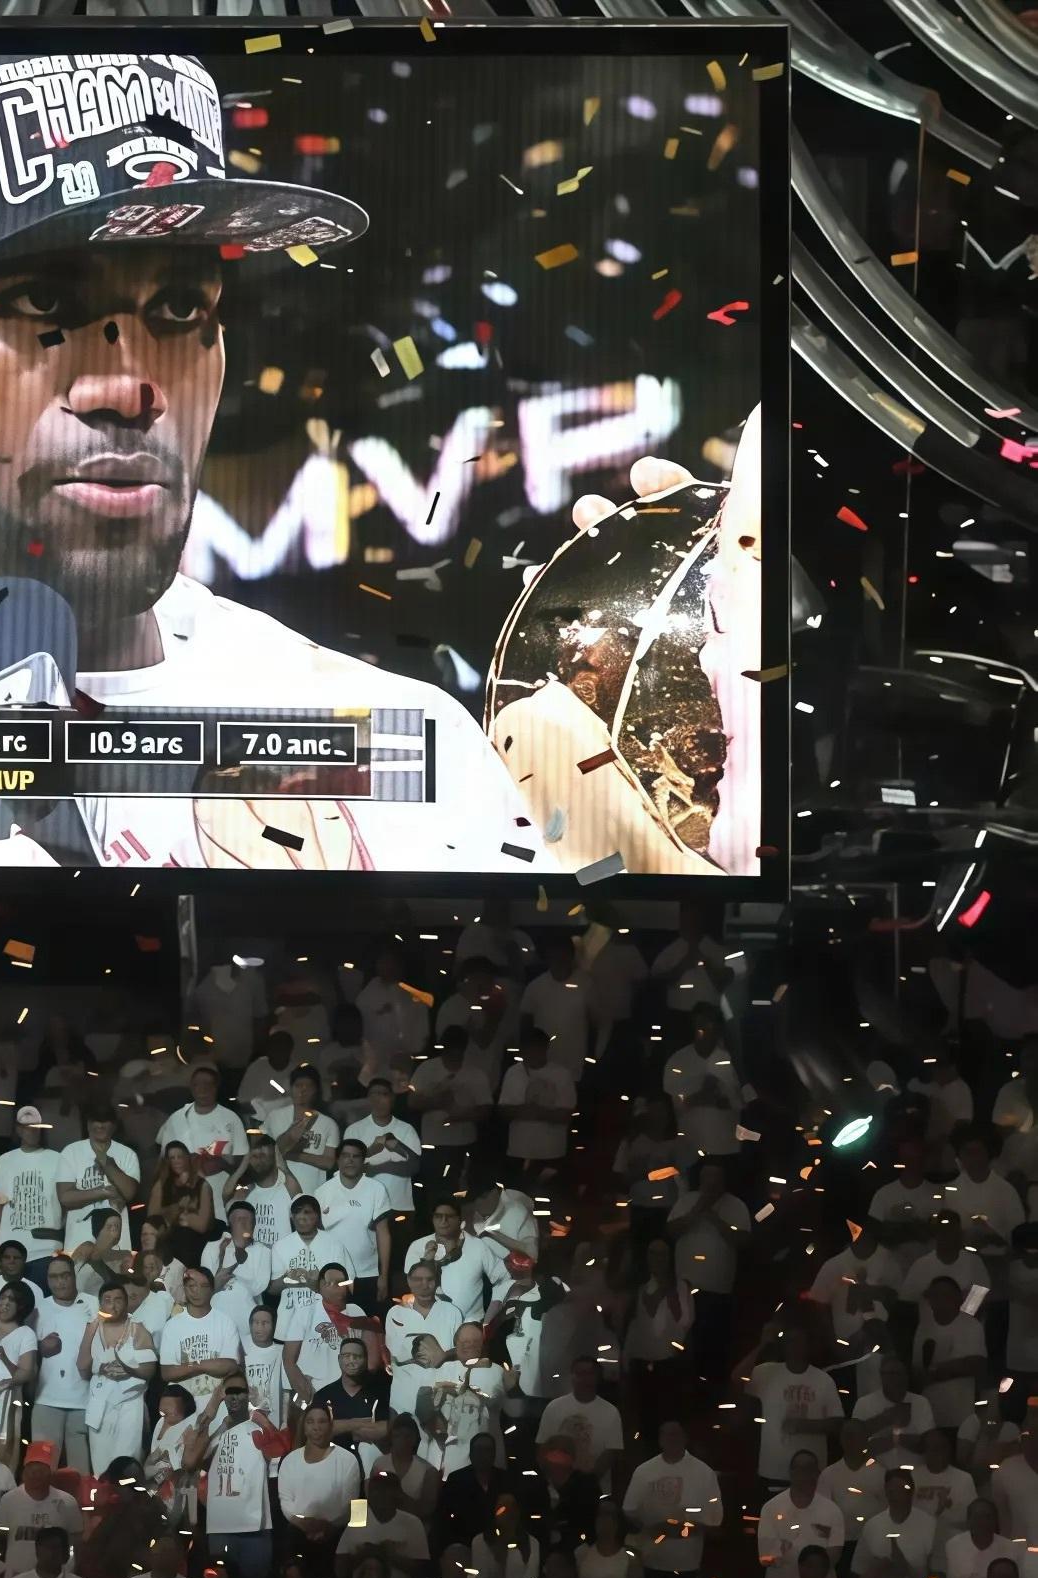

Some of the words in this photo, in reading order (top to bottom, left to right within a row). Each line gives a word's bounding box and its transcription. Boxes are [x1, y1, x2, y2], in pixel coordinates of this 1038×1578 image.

[181, 373, 683, 584] MVP
[90, 731, 137, 755] 10.9
[242, 733, 282, 755] 7.0
